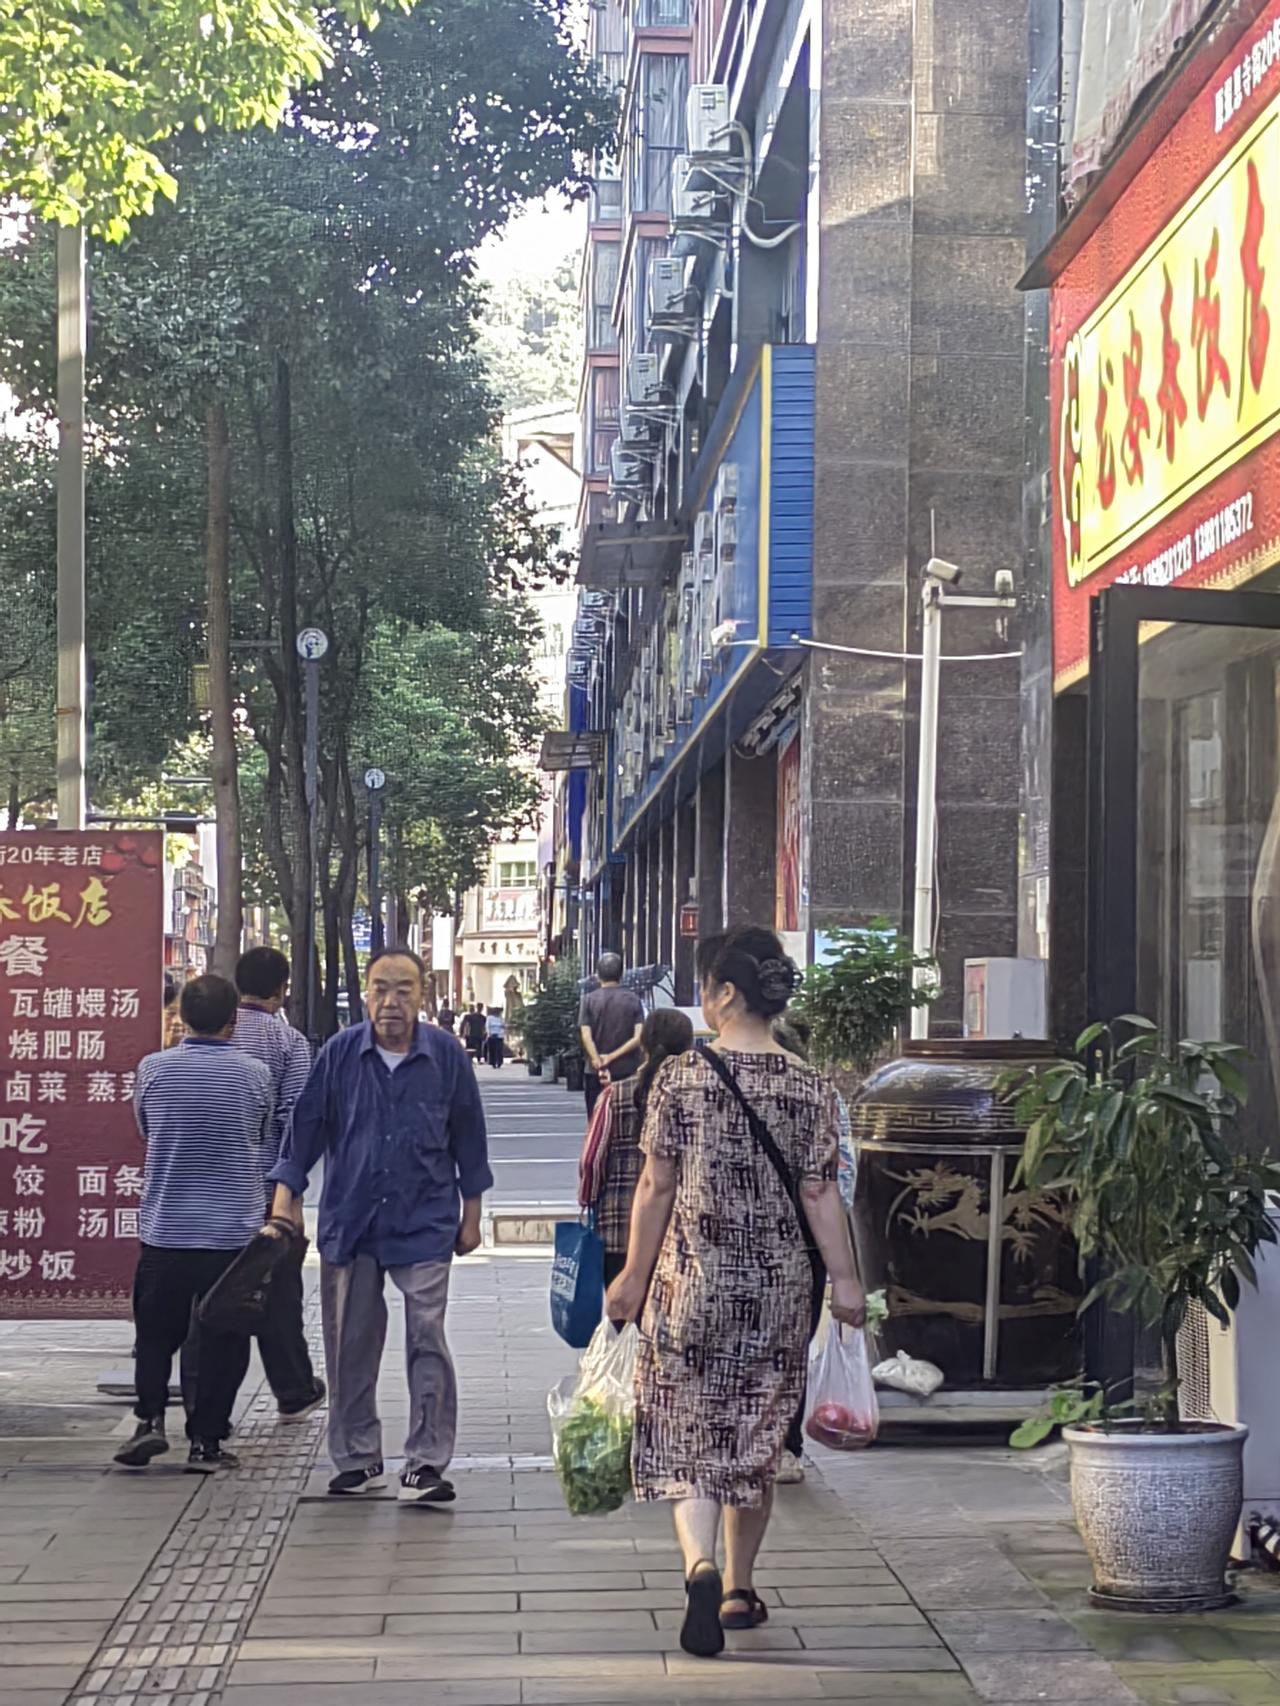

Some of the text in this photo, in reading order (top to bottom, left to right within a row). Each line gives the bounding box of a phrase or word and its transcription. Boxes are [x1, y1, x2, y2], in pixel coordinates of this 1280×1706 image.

[0, 935, 48, 977] 餐
[11, 988, 141, 1019] 瓦罐煨汤
[9, 1029, 107, 1061] 烧肥肠
[6, 1070, 68, 1104] 卤菜
[0, 1113, 48, 1155] 吃
[13, 1164, 144, 1198] 饺 面条
[78, 1207, 140, 1239] 汤圆
[0, 1249, 77, 1281] 炒饭
